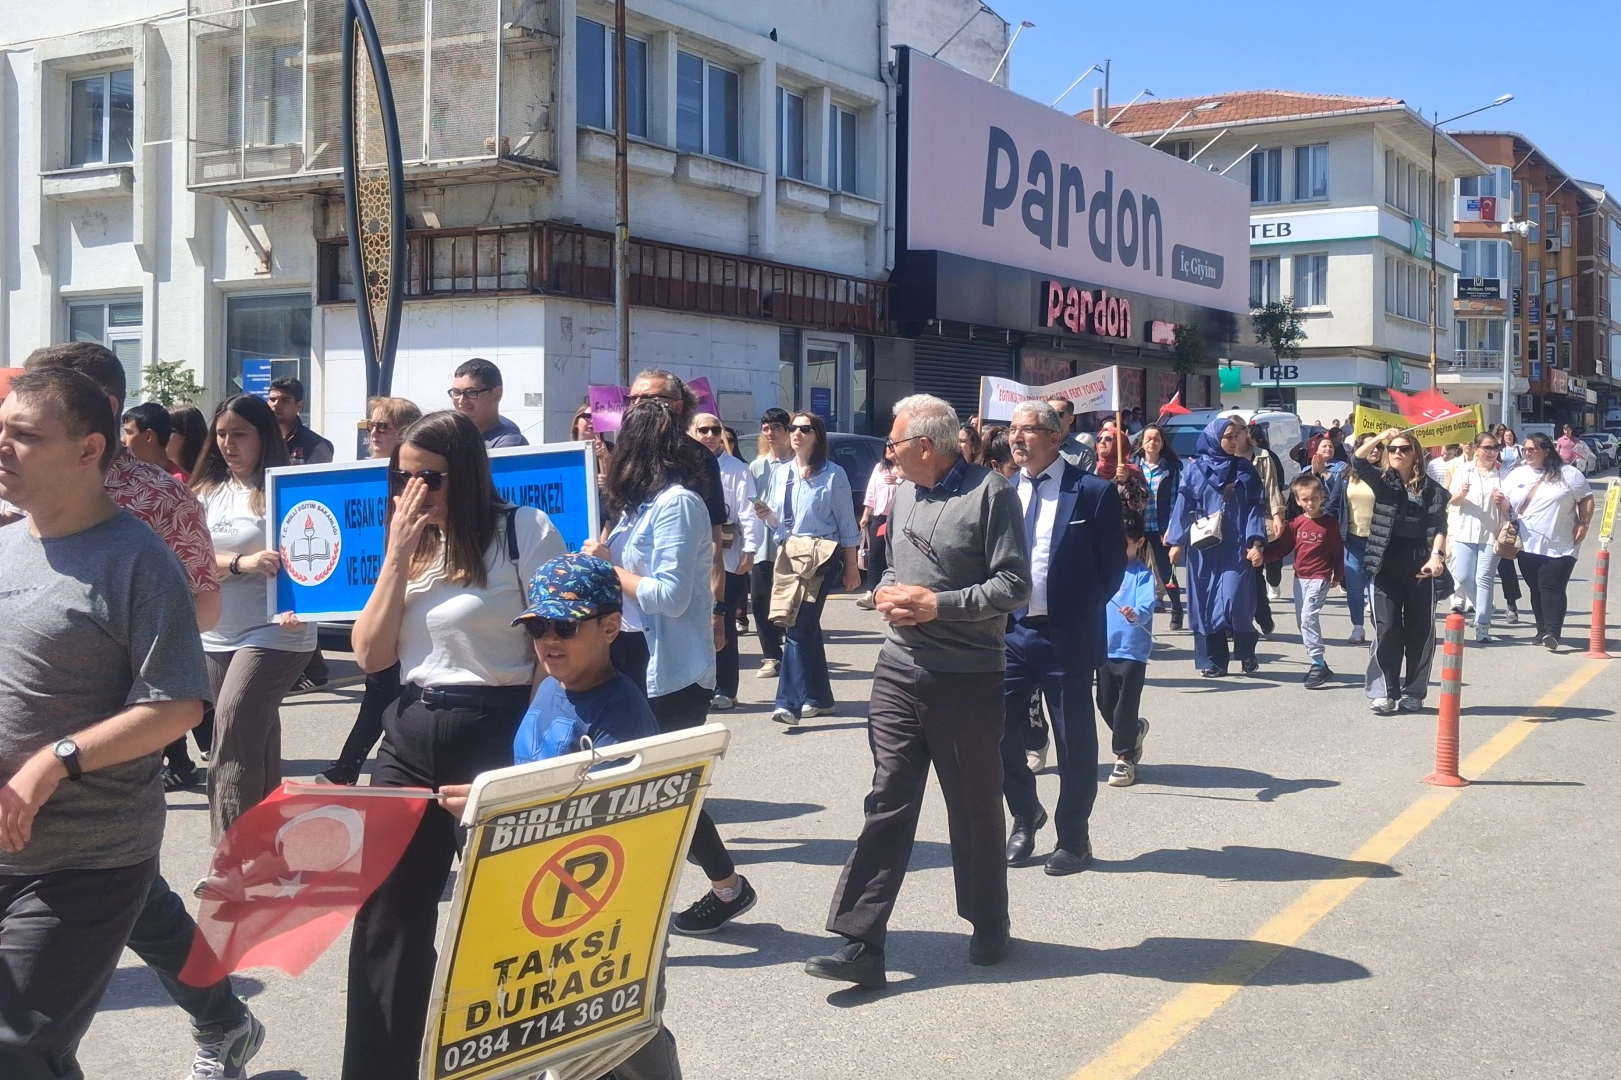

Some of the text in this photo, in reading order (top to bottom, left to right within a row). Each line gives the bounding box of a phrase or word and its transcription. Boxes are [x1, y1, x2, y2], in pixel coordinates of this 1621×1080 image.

[1250, 222, 1292, 239] TEB
[1180, 250, 1216, 280] İç Giyim
[1257, 364, 1299, 380] TEB
[1069, 386, 1083, 400] FERT
[1362, 414, 1375, 429] Özel
[286, 508, 298, 525] MİLLİ
[298, 502, 316, 512] EĞİTİM
[317, 505, 338, 536] BAKANLIĞI
[344, 497, 374, 536] KEŞAN
[519, 474, 564, 514] MERKEZİ
[346, 556, 358, 586] VE
[493, 919, 622, 987] TAKSİ
[465, 952, 632, 1032] DURAĞI
[444, 984, 641, 1072] 0284 714 36 02
